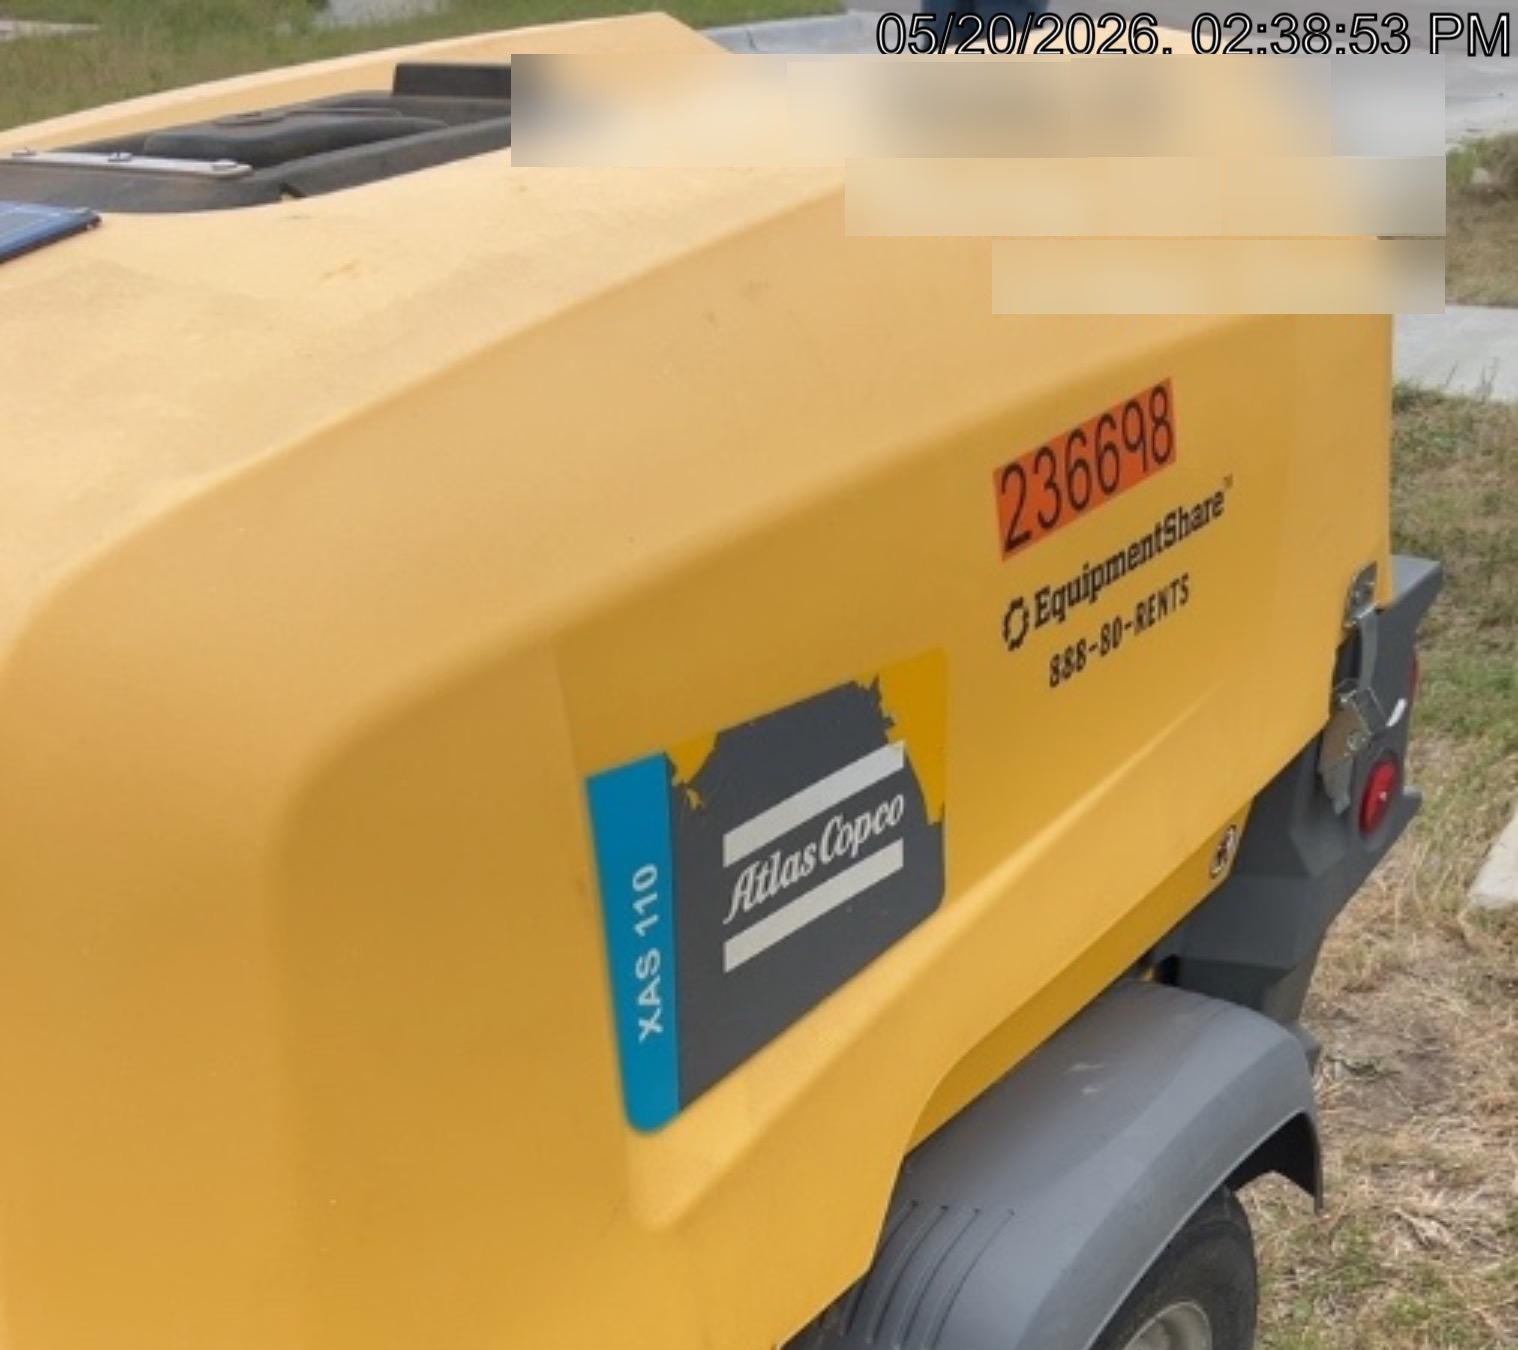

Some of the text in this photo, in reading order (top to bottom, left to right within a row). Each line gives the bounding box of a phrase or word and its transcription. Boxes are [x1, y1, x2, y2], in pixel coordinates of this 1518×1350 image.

[1000, 384, 1174, 553] 236698
[1033, 490, 1224, 629] EquipmentShare
[1049, 573, 1190, 688] 888-80-RENTS
[722, 794, 905, 924] Atlas Copco
[632, 863, 664, 1042] XAS 110
